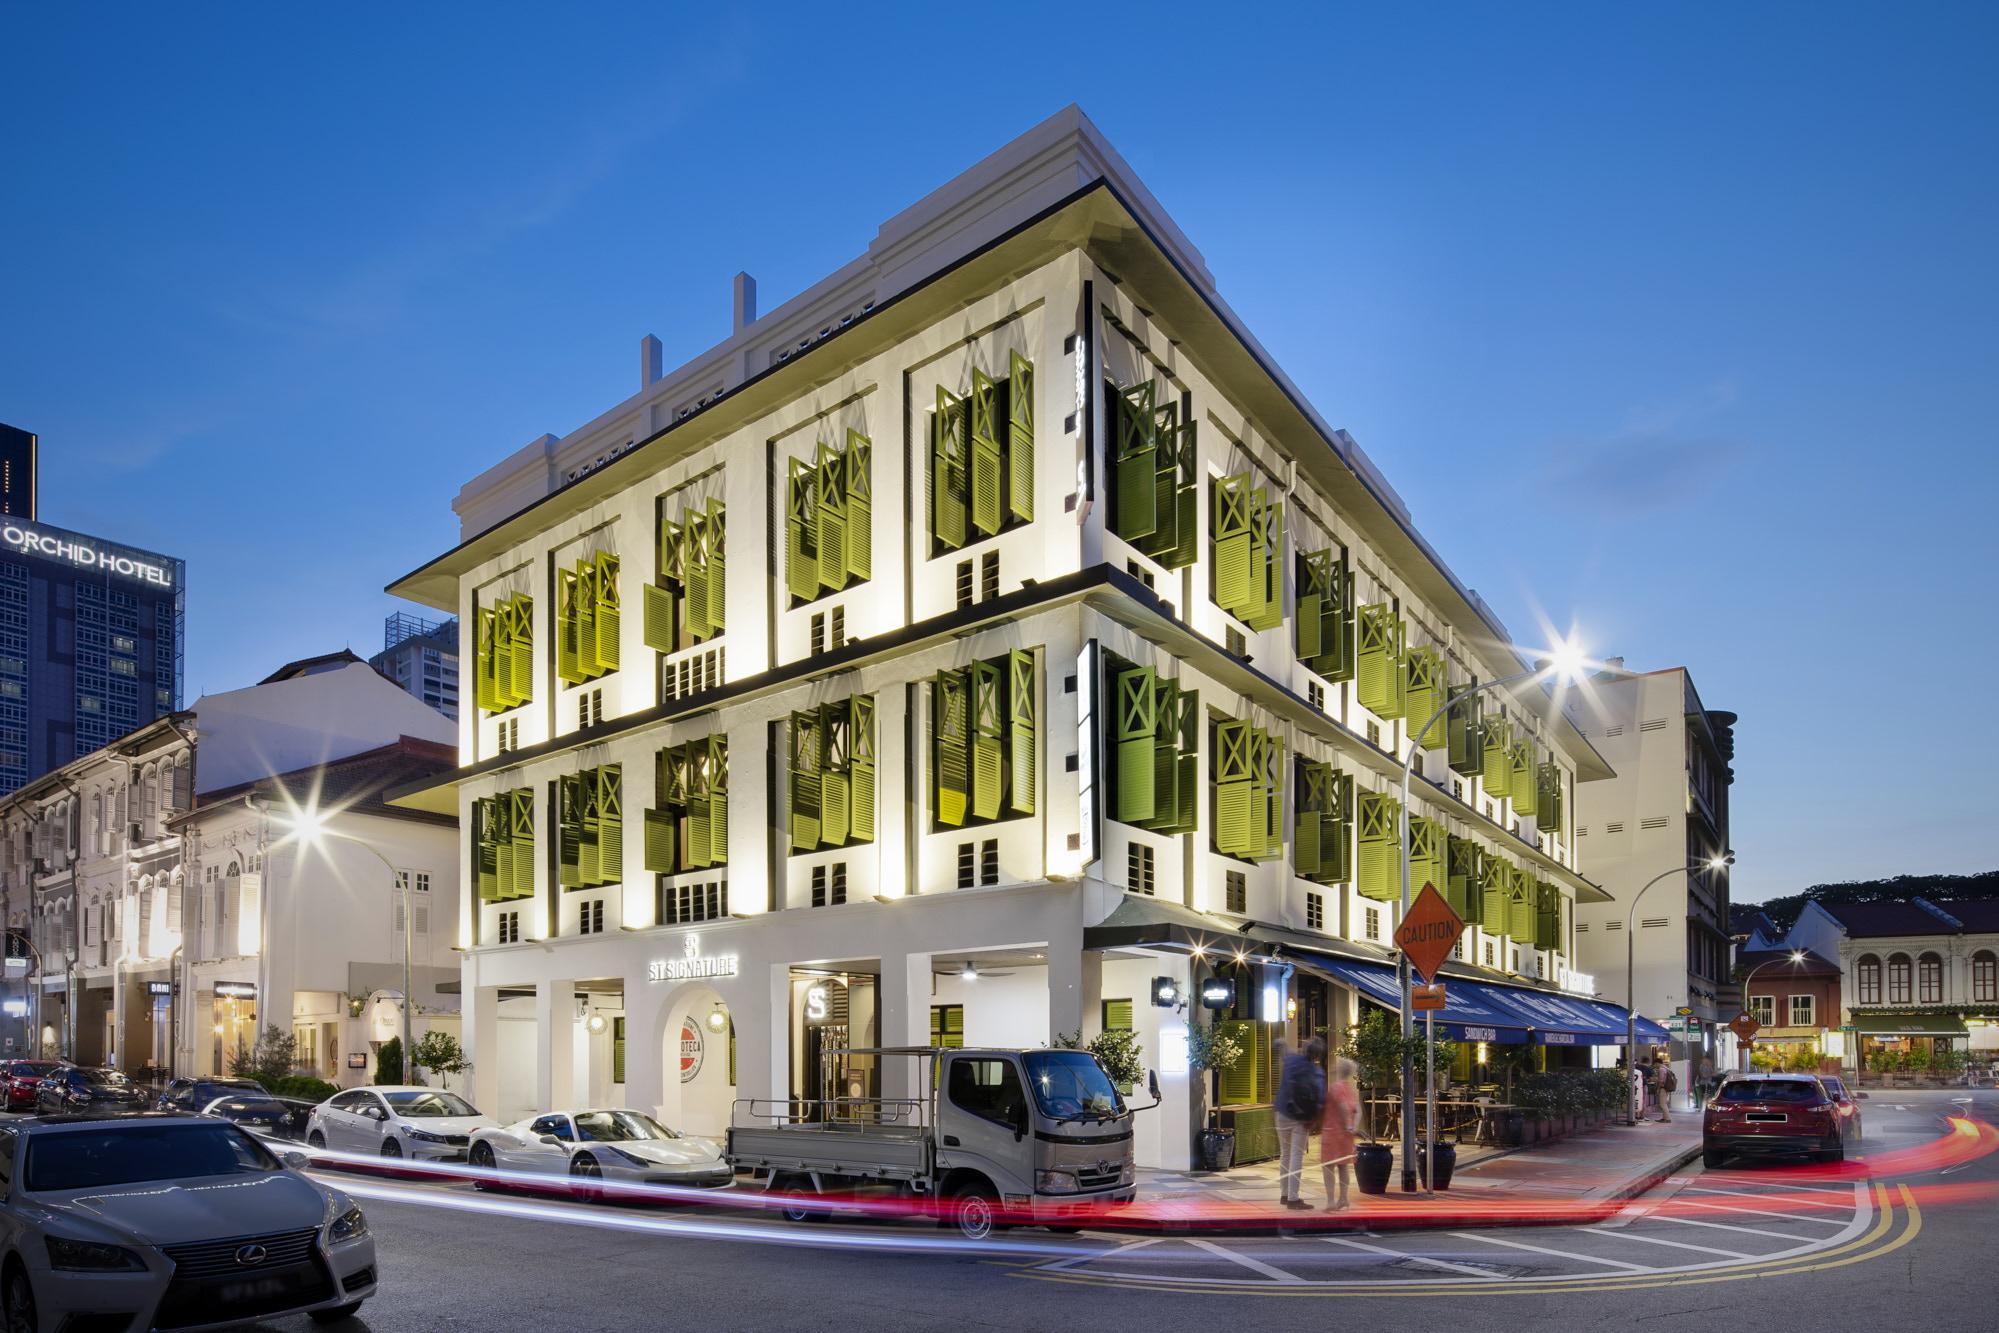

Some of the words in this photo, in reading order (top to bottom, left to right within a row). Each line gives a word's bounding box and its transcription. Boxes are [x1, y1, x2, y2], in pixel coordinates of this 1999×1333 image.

[3, 526, 95, 564] ORCHID
[99, 552, 170, 586] HOTEL
[1403, 921, 1454, 944] CAUTION
[665, 956, 736, 979] SIGNATURE
